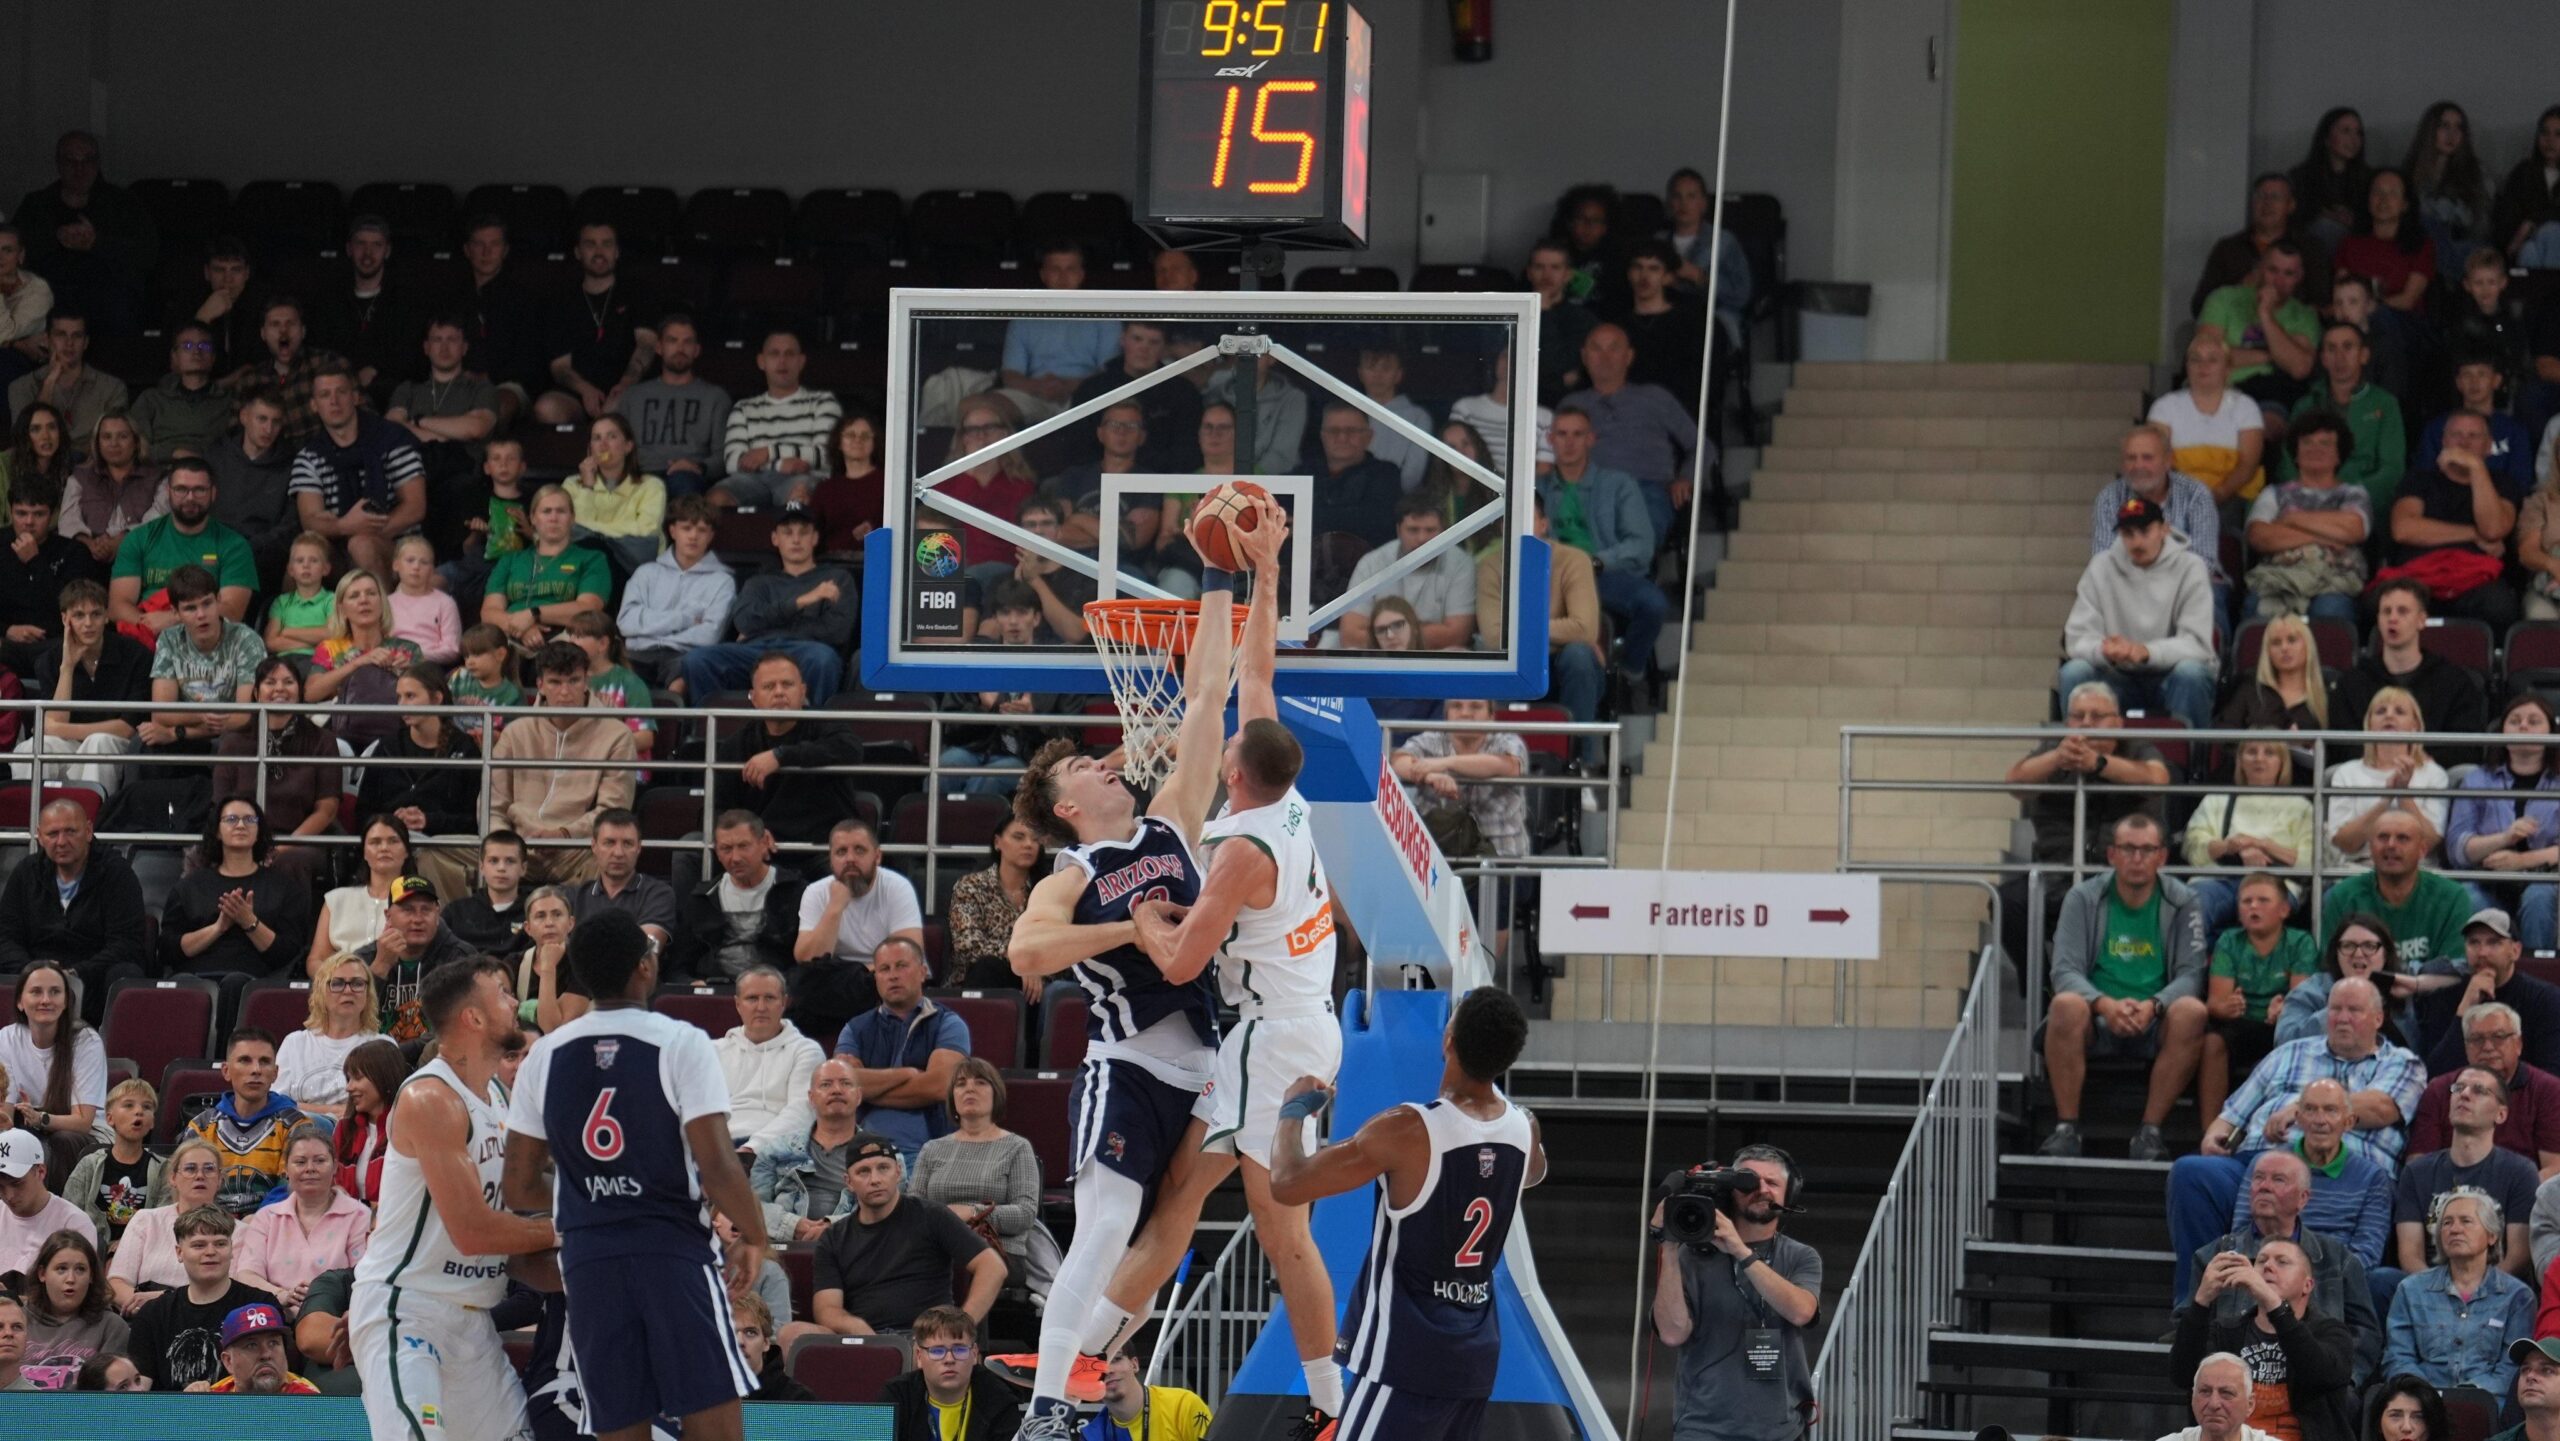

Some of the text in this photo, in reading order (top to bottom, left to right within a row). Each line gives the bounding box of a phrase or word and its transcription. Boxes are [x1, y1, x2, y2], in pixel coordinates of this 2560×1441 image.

[1201, 0, 1328, 56] 9:51
[1212, 81, 1317, 193] 15
[642, 398, 701, 445] GAP
[920, 592, 956, 609] FIBA
[1378, 757, 1431, 901] HESBURGER
[1095, 854, 1184, 906] ARIZONA
[1649, 902, 1768, 927] Parteris D
[582, 1087, 625, 1161] 6
[585, 1174, 642, 1202] JAMES
[1455, 1197, 1493, 1267] 2
[247, 1312, 267, 1328] 76
